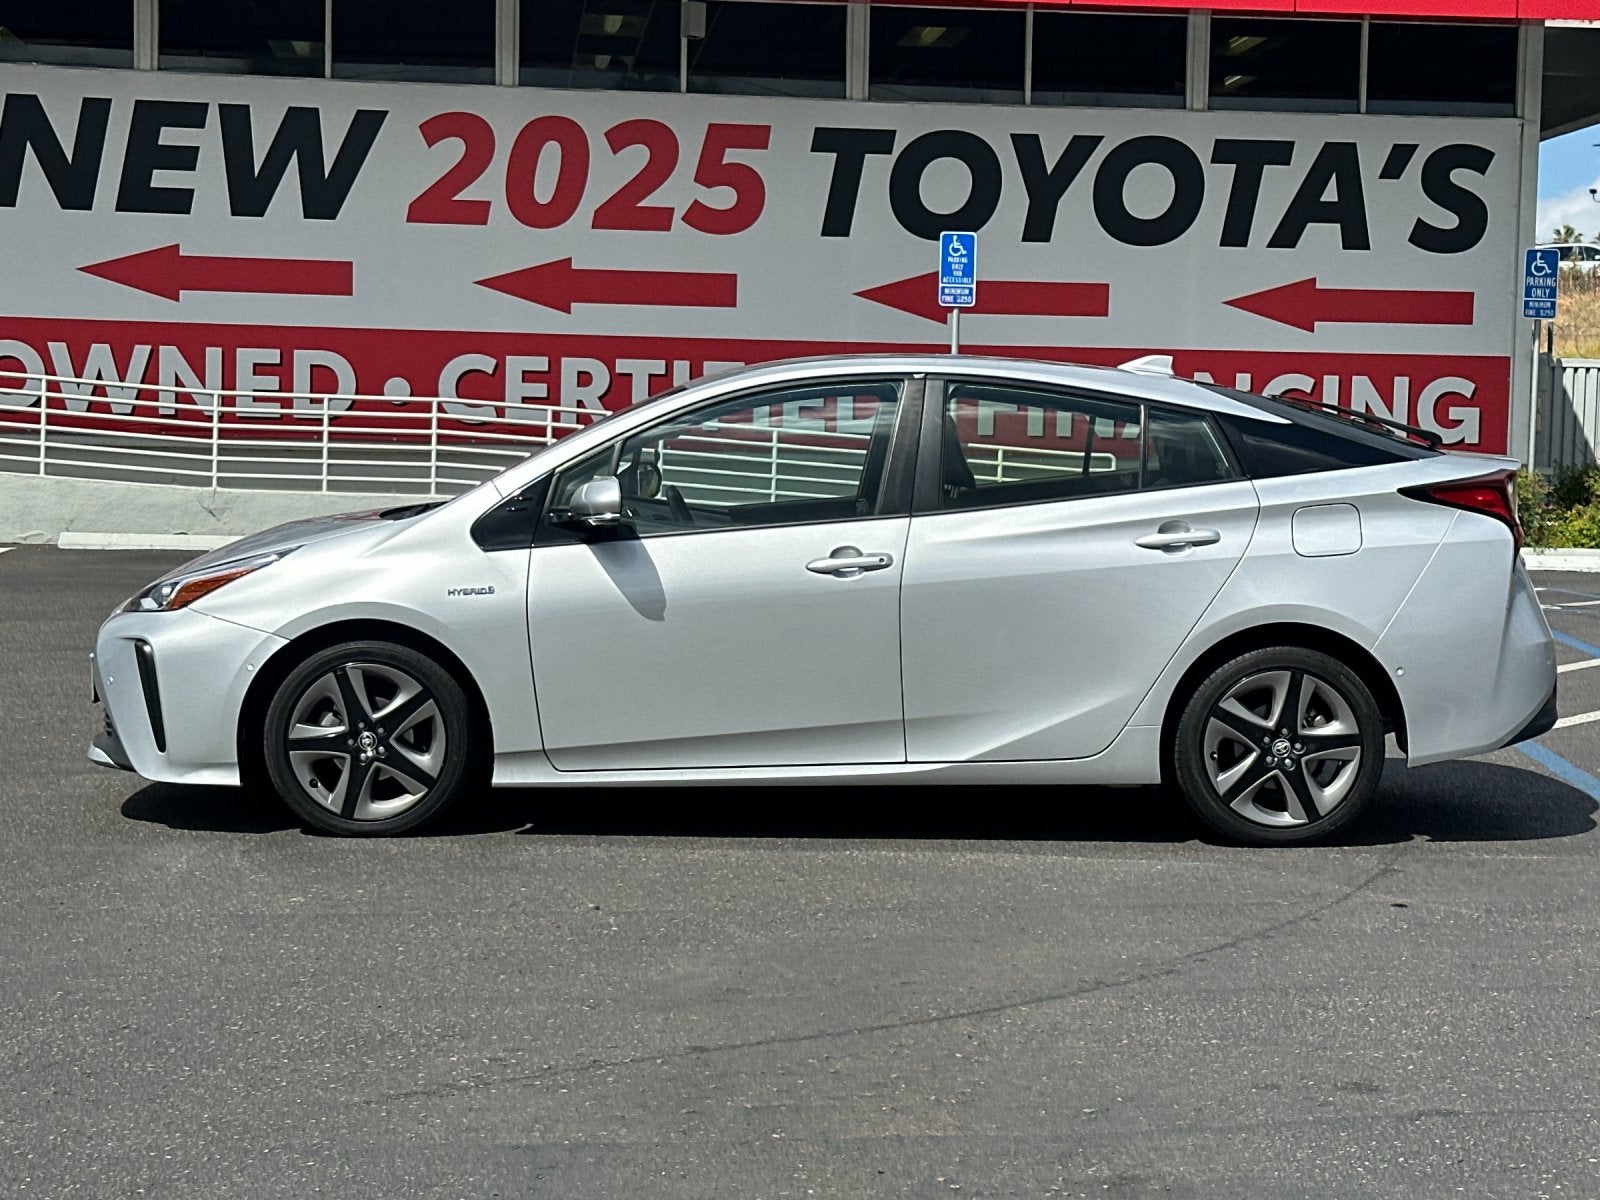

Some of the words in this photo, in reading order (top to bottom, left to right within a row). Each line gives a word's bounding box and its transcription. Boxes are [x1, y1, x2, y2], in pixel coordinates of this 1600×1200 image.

[0, 93, 389, 220] NEW
[406, 112, 771, 235] 2025
[811, 127, 1496, 254] TOYOTA'S
[948, 256, 968, 264] PARKING
[1526, 276, 1556, 287] PARKING
[1531, 288, 1551, 298] ONLY
[0, 339, 357, 418] OWNED
[438, 354, 896, 433] CERTED
[447, 587, 487, 597] HYBRID
